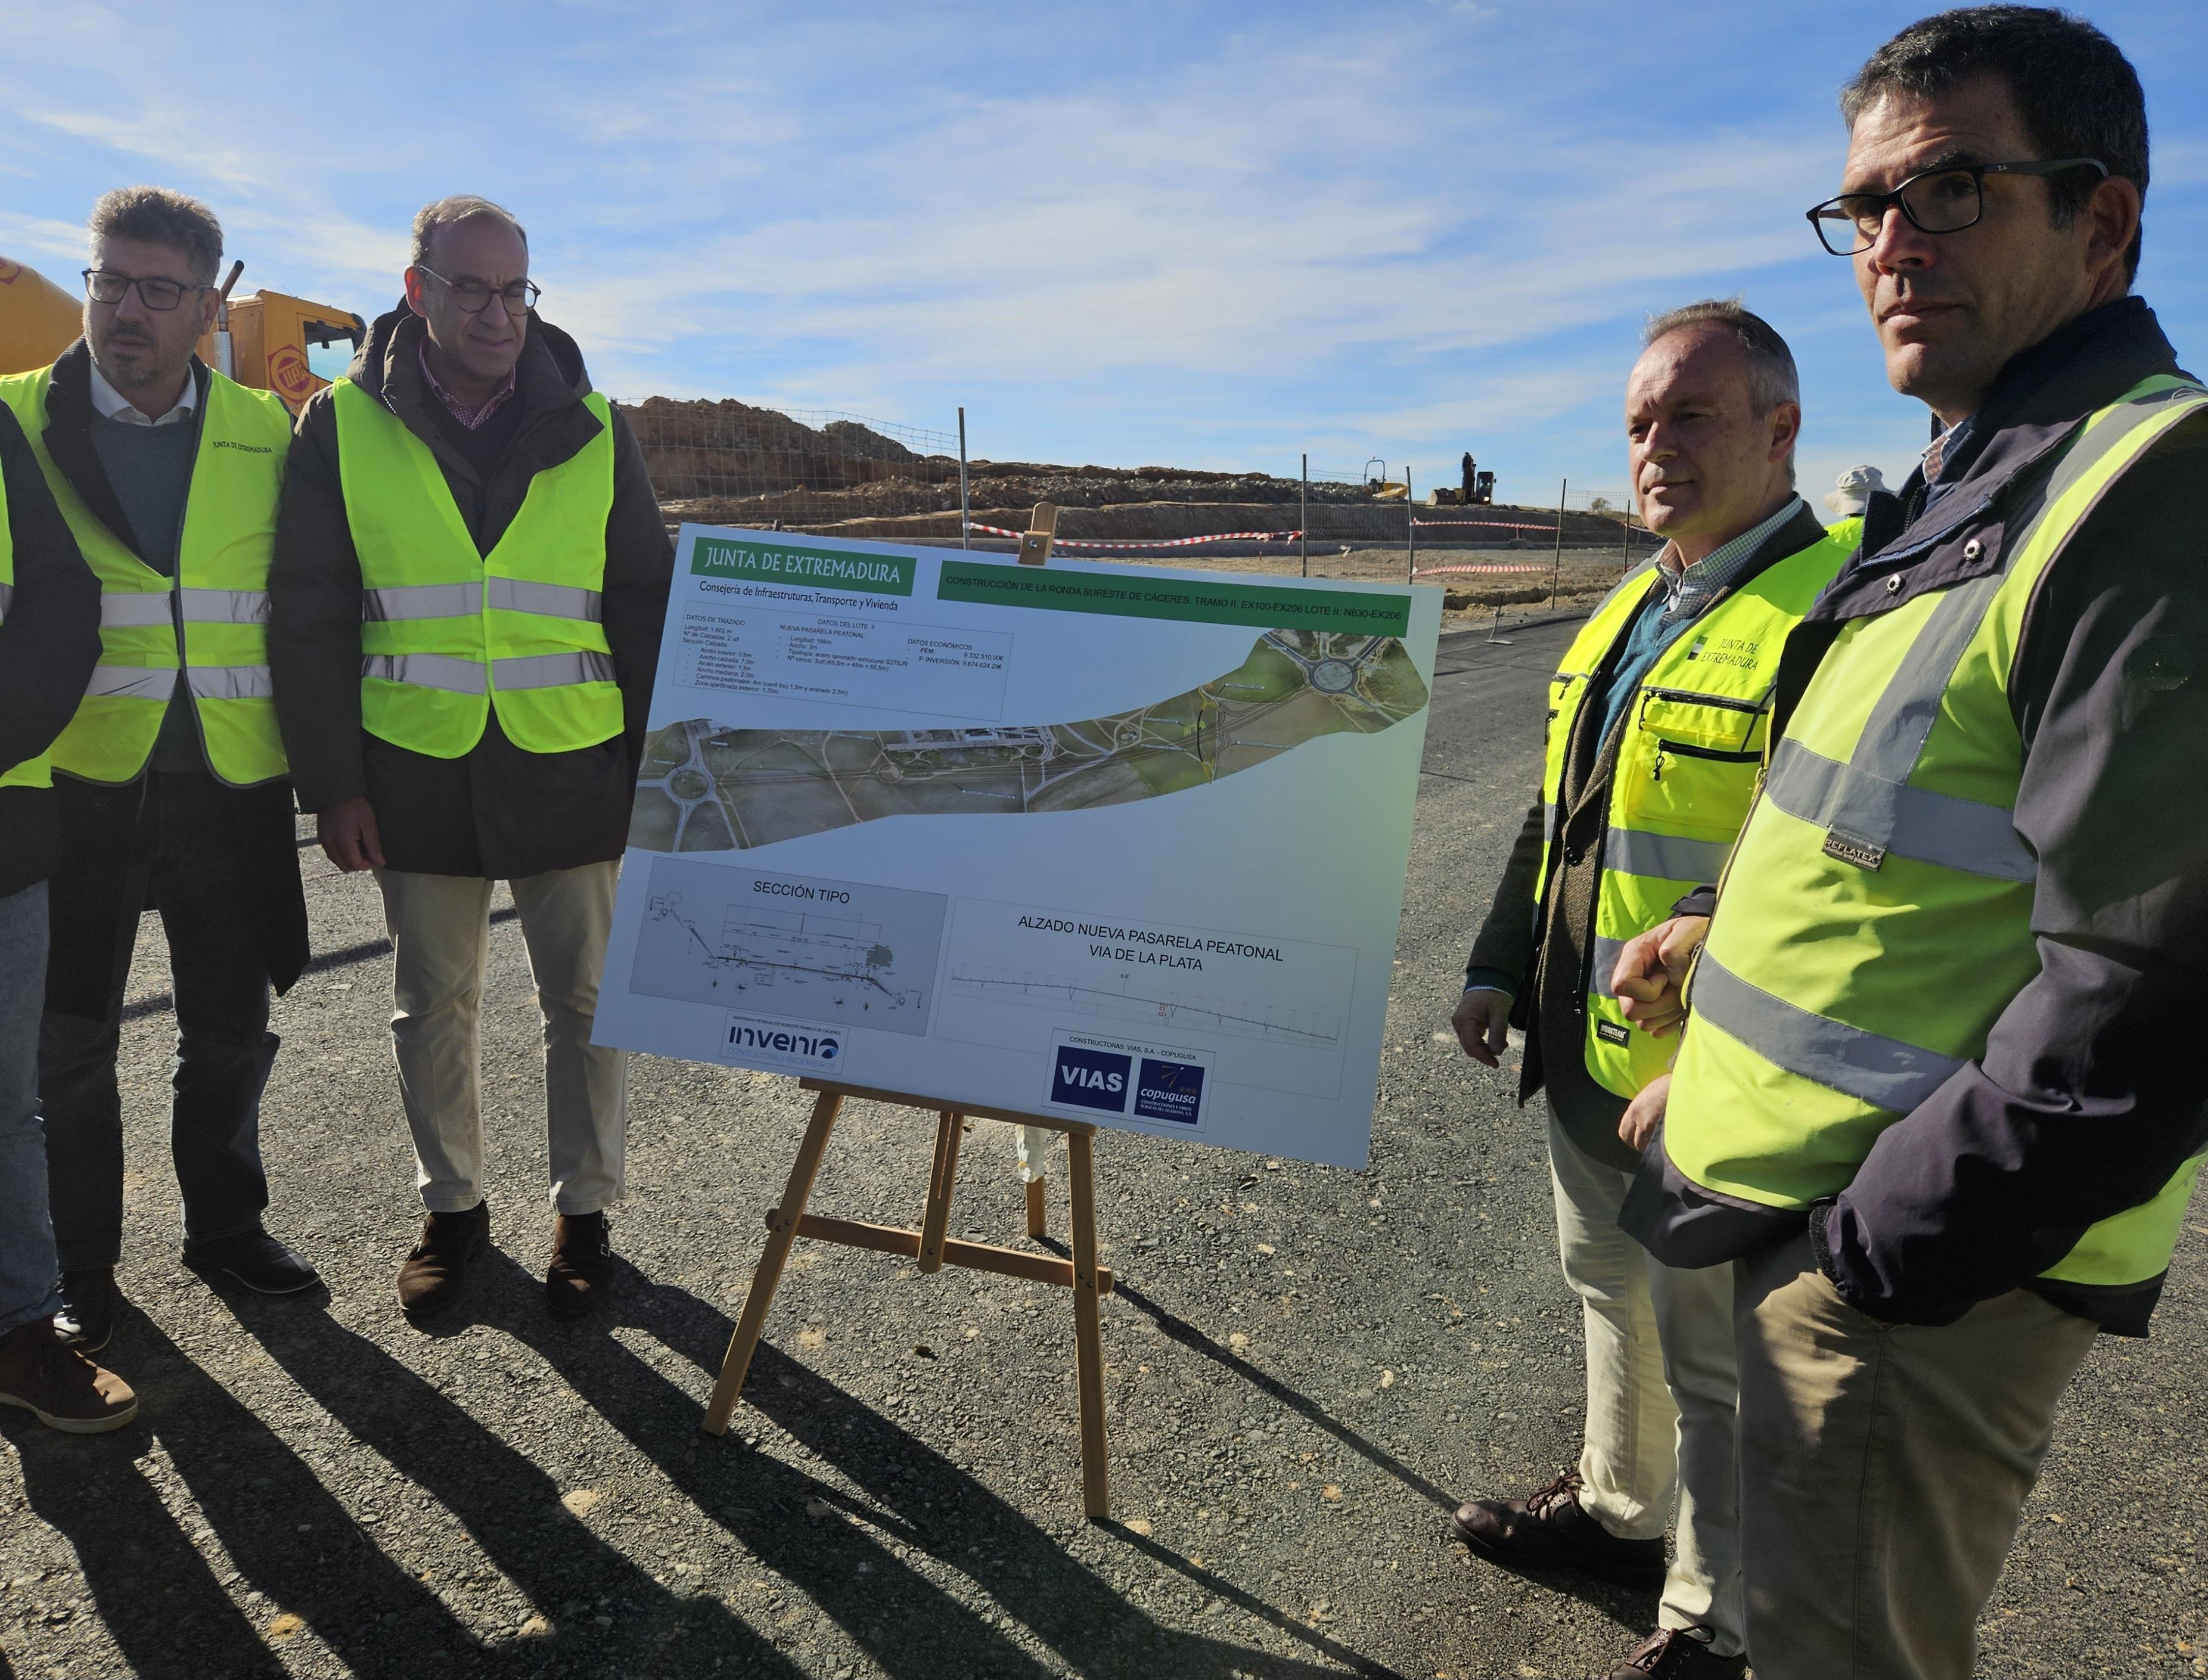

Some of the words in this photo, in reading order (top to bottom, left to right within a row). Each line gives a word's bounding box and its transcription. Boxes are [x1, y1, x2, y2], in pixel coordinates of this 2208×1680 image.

[213, 441, 230, 449] JUNTA
[238, 443, 272, 453] EXTREMADURA
[705, 547, 756, 569] JUNTA
[762, 552, 781, 571] DE
[785, 555, 900, 583] EXTREMADURA
[700, 581, 740, 595] Consejería
[743, 586, 753, 595] de
[755, 586, 813, 604] Infraestruturas,
[815, 593, 857, 608] Transporte
[859, 600, 864, 610] y
[866, 598, 898, 610] Vivienda
[946, 576, 1019, 590] CONSTRUCCIÓN
[1021, 582, 1033, 591] DE
[1036, 583, 1047, 592] LA
[1049, 585, 1082, 595] RONDA
[1083, 588, 1126, 600] SURESTE
[1131, 591, 1142, 601] DE
[1144, 591, 1191, 604] CÁCERES.
[1195, 597, 1228, 607] TRAMO
[1231, 600, 1239, 608] II:
[1241, 600, 1303, 613] EX100-EX206
[1305, 604, 1330, 615] LOTE
[1344, 609, 1401, 620] N630-EX206
[718, 617, 746, 626] TRAZADO
[801, 626, 833, 635] PASARELA
[1717, 638, 1745, 651] JUNTA
[1746, 642, 1759, 654] DE
[886, 659, 908, 667] S275JR
[1701, 652, 1759, 670] EXTREMADURA
[753, 881, 815, 899] SECCIÓN
[819, 889, 850, 904] TIPO
[1018, 916, 1074, 933] ALZADO
[1078, 923, 1125, 940] NUEVA
[1129, 930, 1203, 951] PASARELA
[1207, 940, 1283, 961] PEATONAL
[1090, 945, 1111, 959] VIA
[1115, 948, 1135, 962] DE
[1138, 951, 1156, 965] LA
[1159, 954, 1203, 971] PLATA
[727, 1046, 785, 1062] CONSULTORES
[787, 1057, 836, 1070] INGENIEROS
[1070, 1036, 1125, 1049] CONSTRUCTORAS:
[1127, 1045, 1142, 1053] VIAS,
[1161, 1050, 1196, 1061] COPUGUSA
[1061, 1065, 1123, 1092] VIAS
[1141, 1088, 1196, 1104] copugusa
